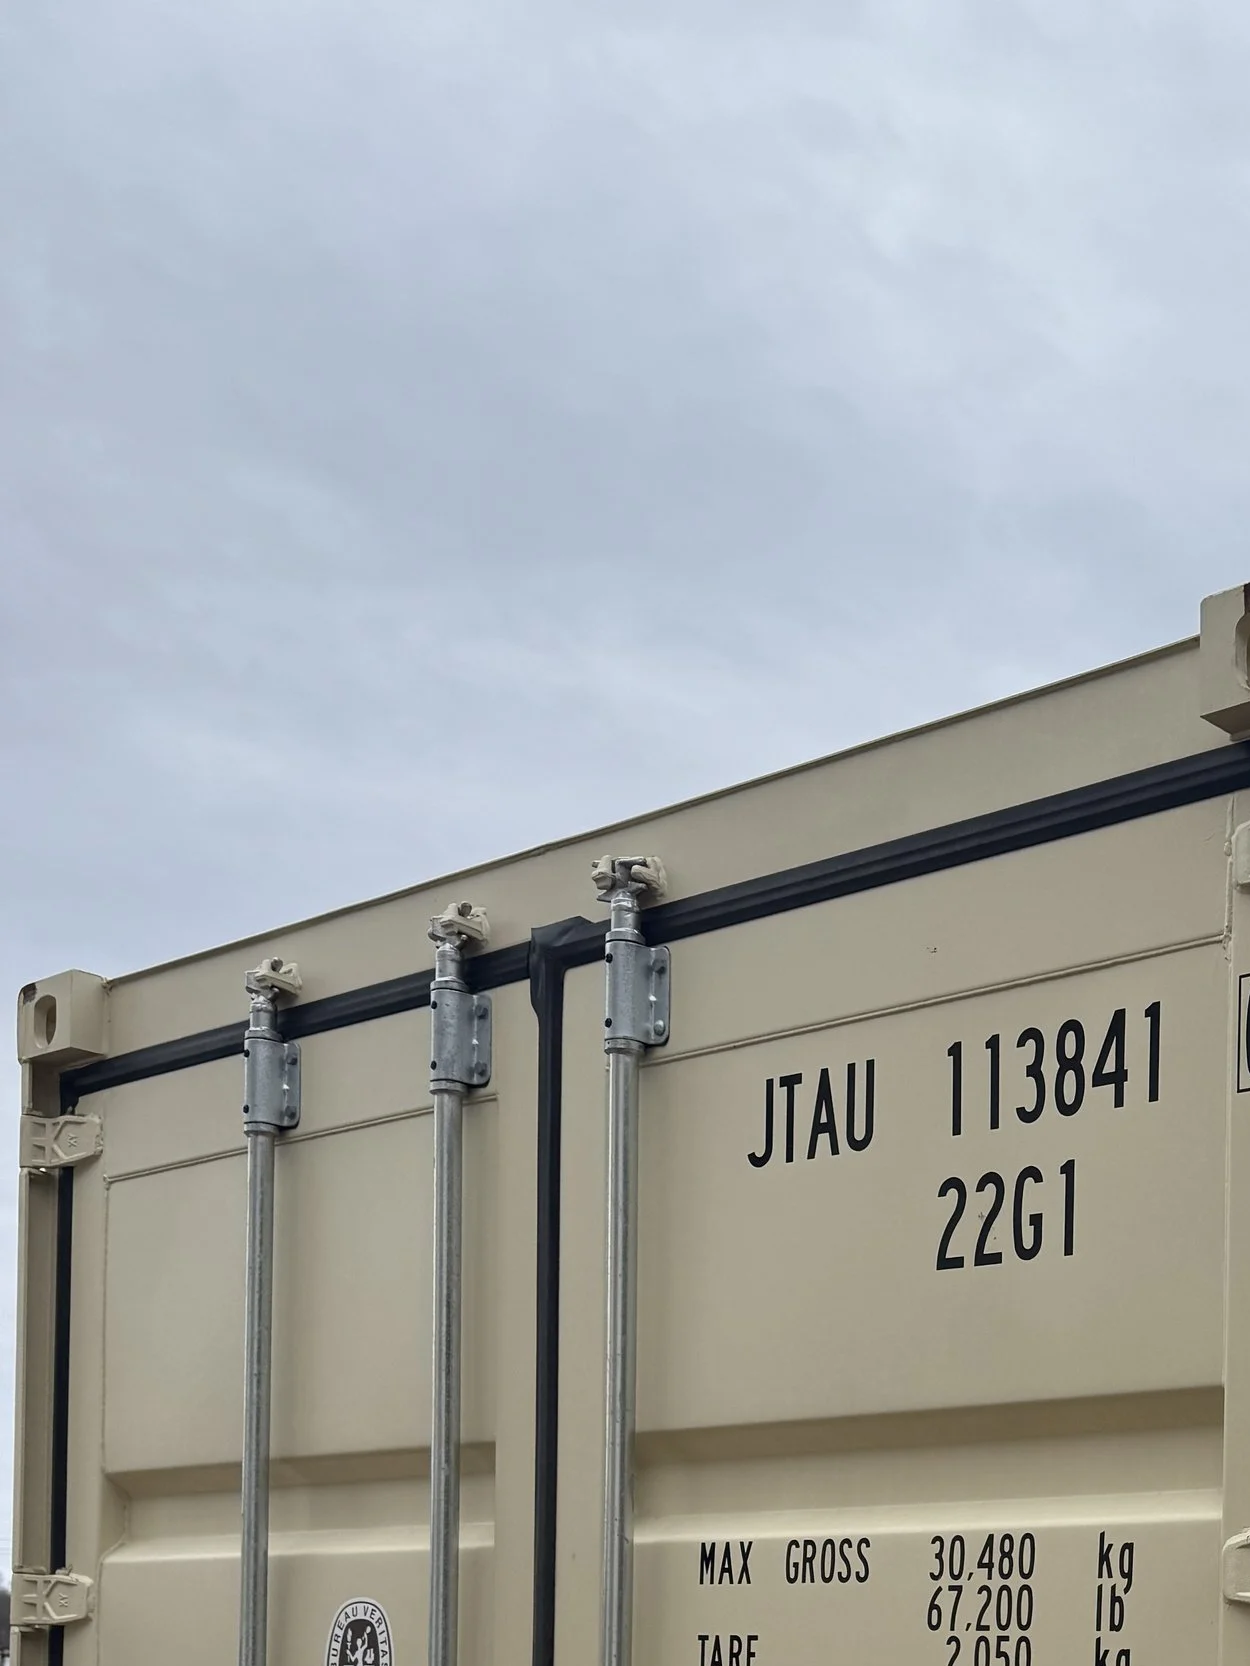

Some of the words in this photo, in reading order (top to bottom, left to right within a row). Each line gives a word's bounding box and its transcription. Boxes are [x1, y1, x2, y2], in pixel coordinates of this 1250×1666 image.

[747, 1058, 875, 1168] JTAU
[947, 1000, 1161, 1137] 113841
[936, 1158, 1075, 1271] 22G1
[699, 1541, 753, 1585] MAX
[785, 1537, 871, 1584] GROSS
[929, 1532, 1036, 1582] 30,480
[1097, 1531, 1135, 1595] kg
[926, 1584, 1033, 1632] 67,200
[1095, 1584, 1125, 1633] lb
